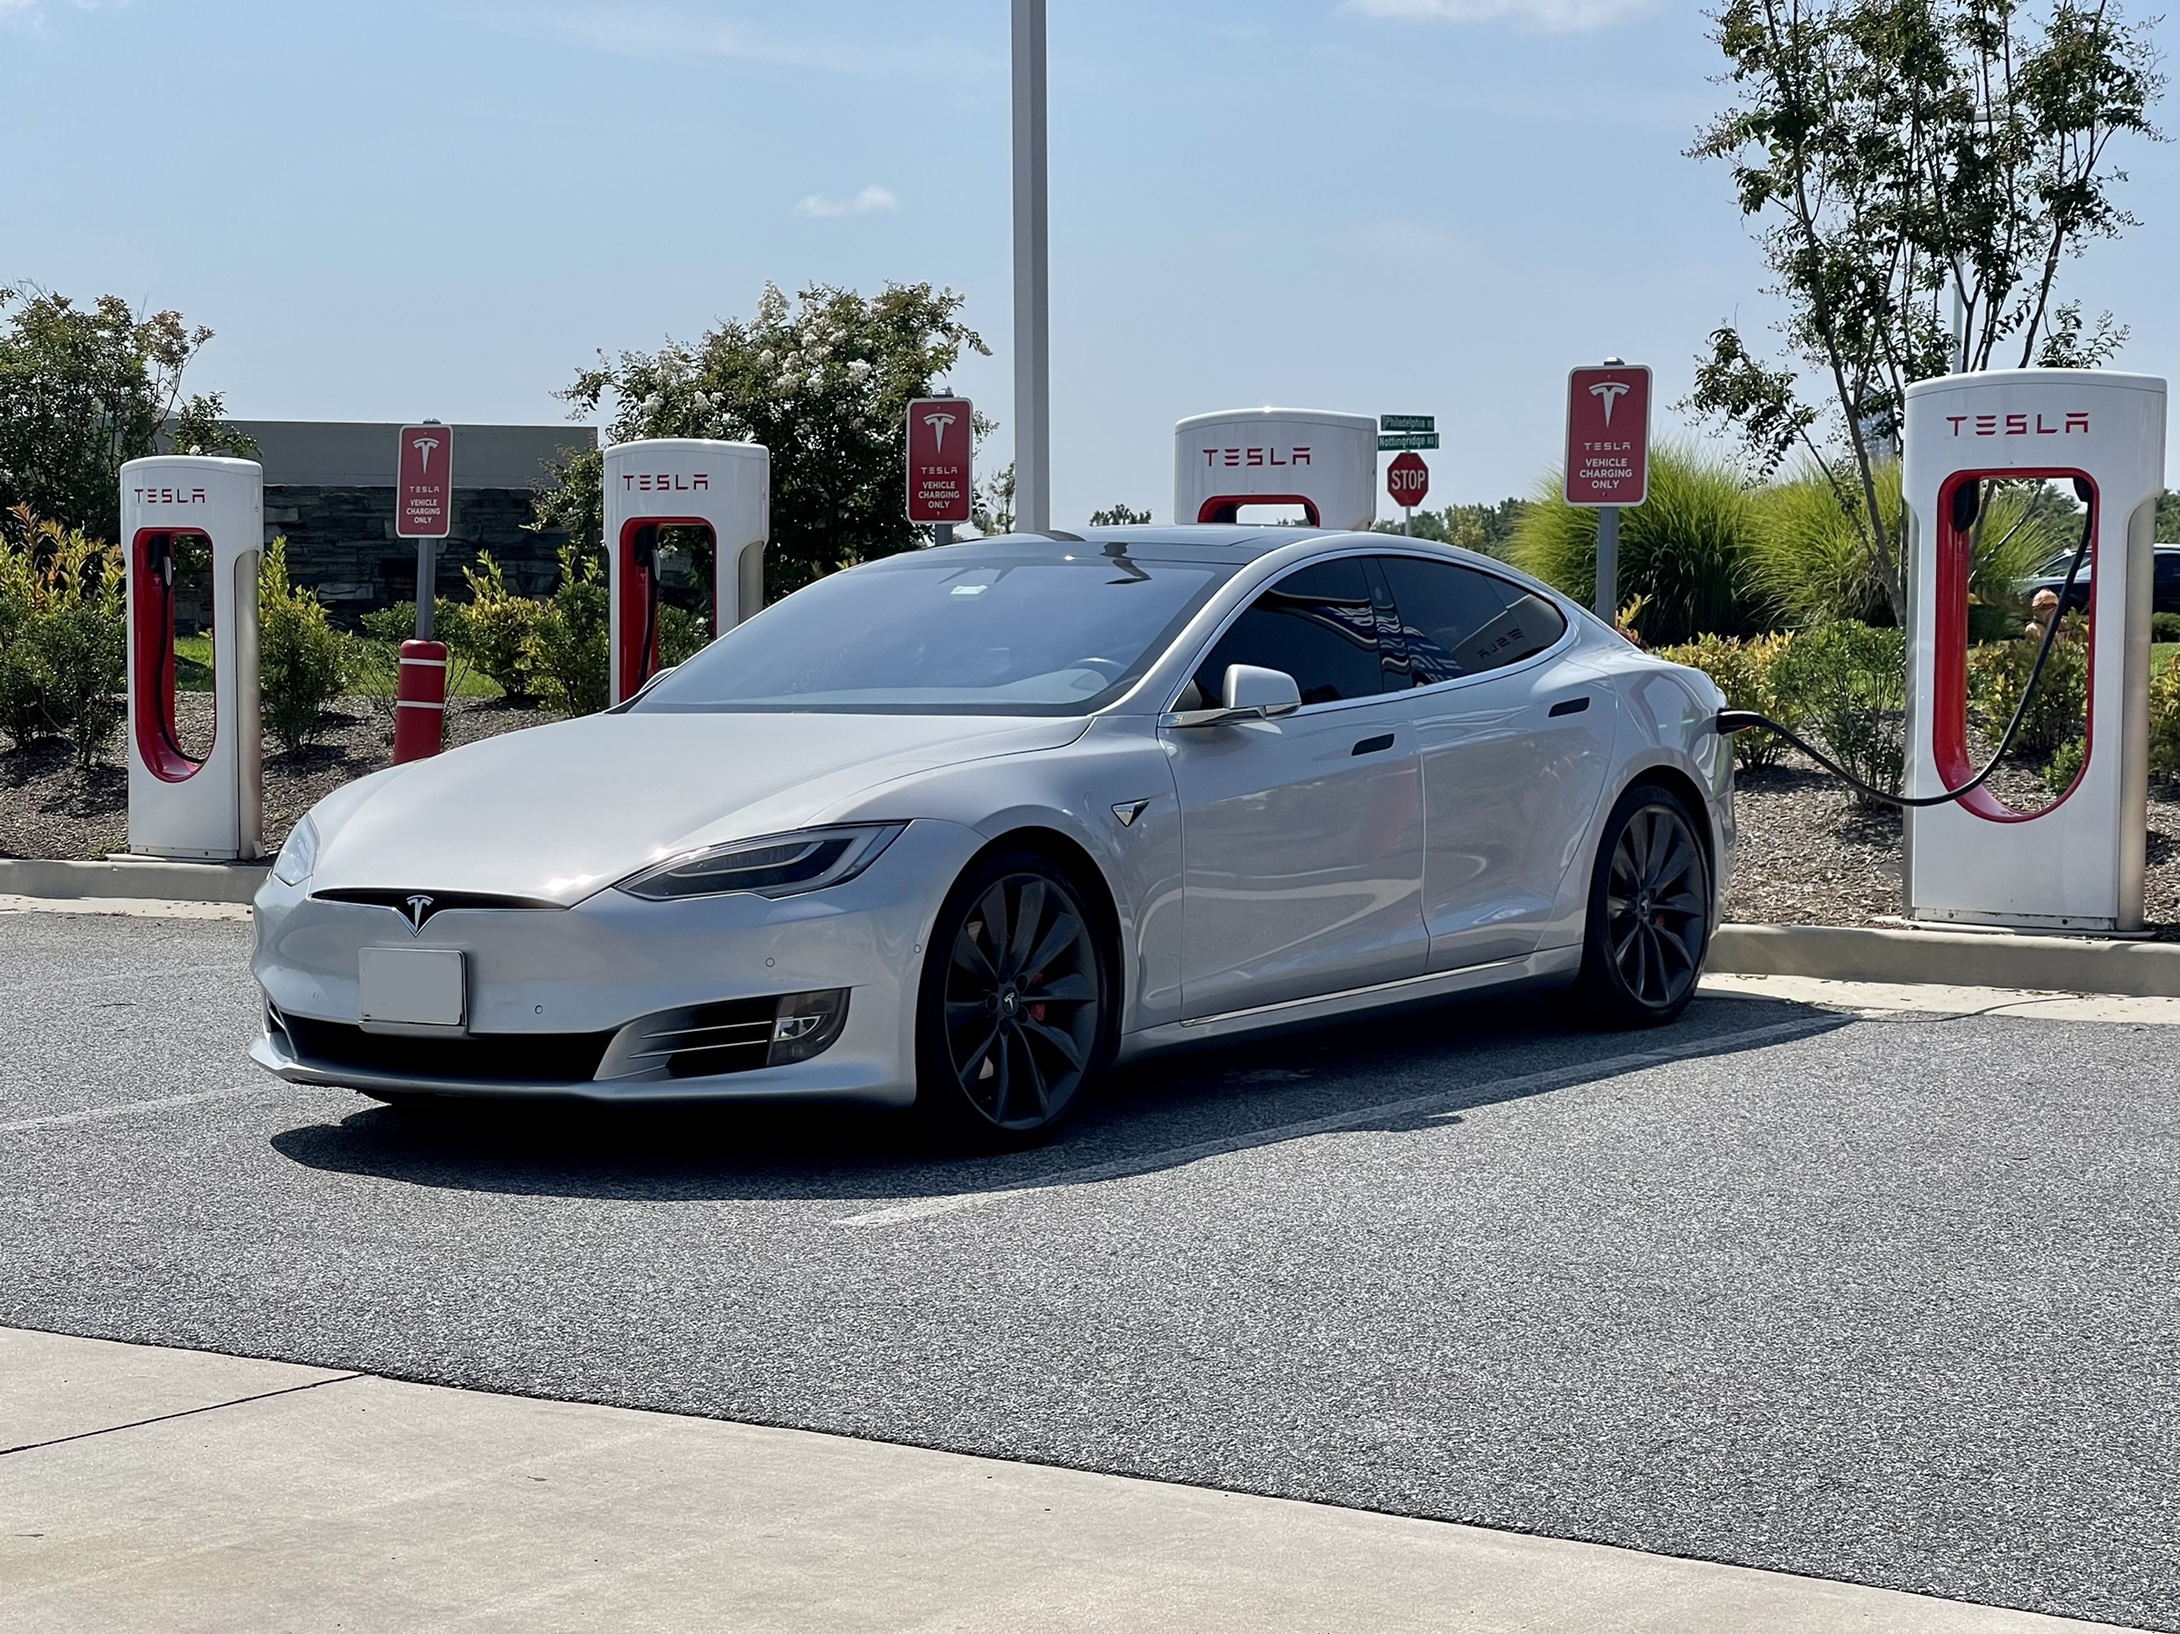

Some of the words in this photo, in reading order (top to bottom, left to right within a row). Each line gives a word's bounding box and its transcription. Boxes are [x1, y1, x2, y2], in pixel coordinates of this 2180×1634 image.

[1385, 416, 1425, 430] Philadelphia
[1945, 412, 2090, 437] TESLA
[1379, 435, 1426, 449] Nottingridge
[1584, 441, 1631, 451] TESLA
[1202, 447, 1311, 467] TESLA
[1585, 458, 1628, 467] VEHICLE
[920, 466, 958, 475] TESLA
[1579, 468, 1633, 478] CHARGING
[622, 473, 708, 491] TESLA
[1391, 469, 1426, 490] STOP
[409, 485, 440, 493] TESLA
[922, 481, 956, 489] VEHICLE
[1591, 480, 1620, 489] ONLY
[134, 488, 206, 503] TESLA
[918, 490, 960, 499] CHARGING
[410, 498, 438, 507] VEHICLE
[927, 500, 951, 509] ONLY
[406, 507, 441, 515] CHARGING
[413, 516, 433, 524] ONLY
